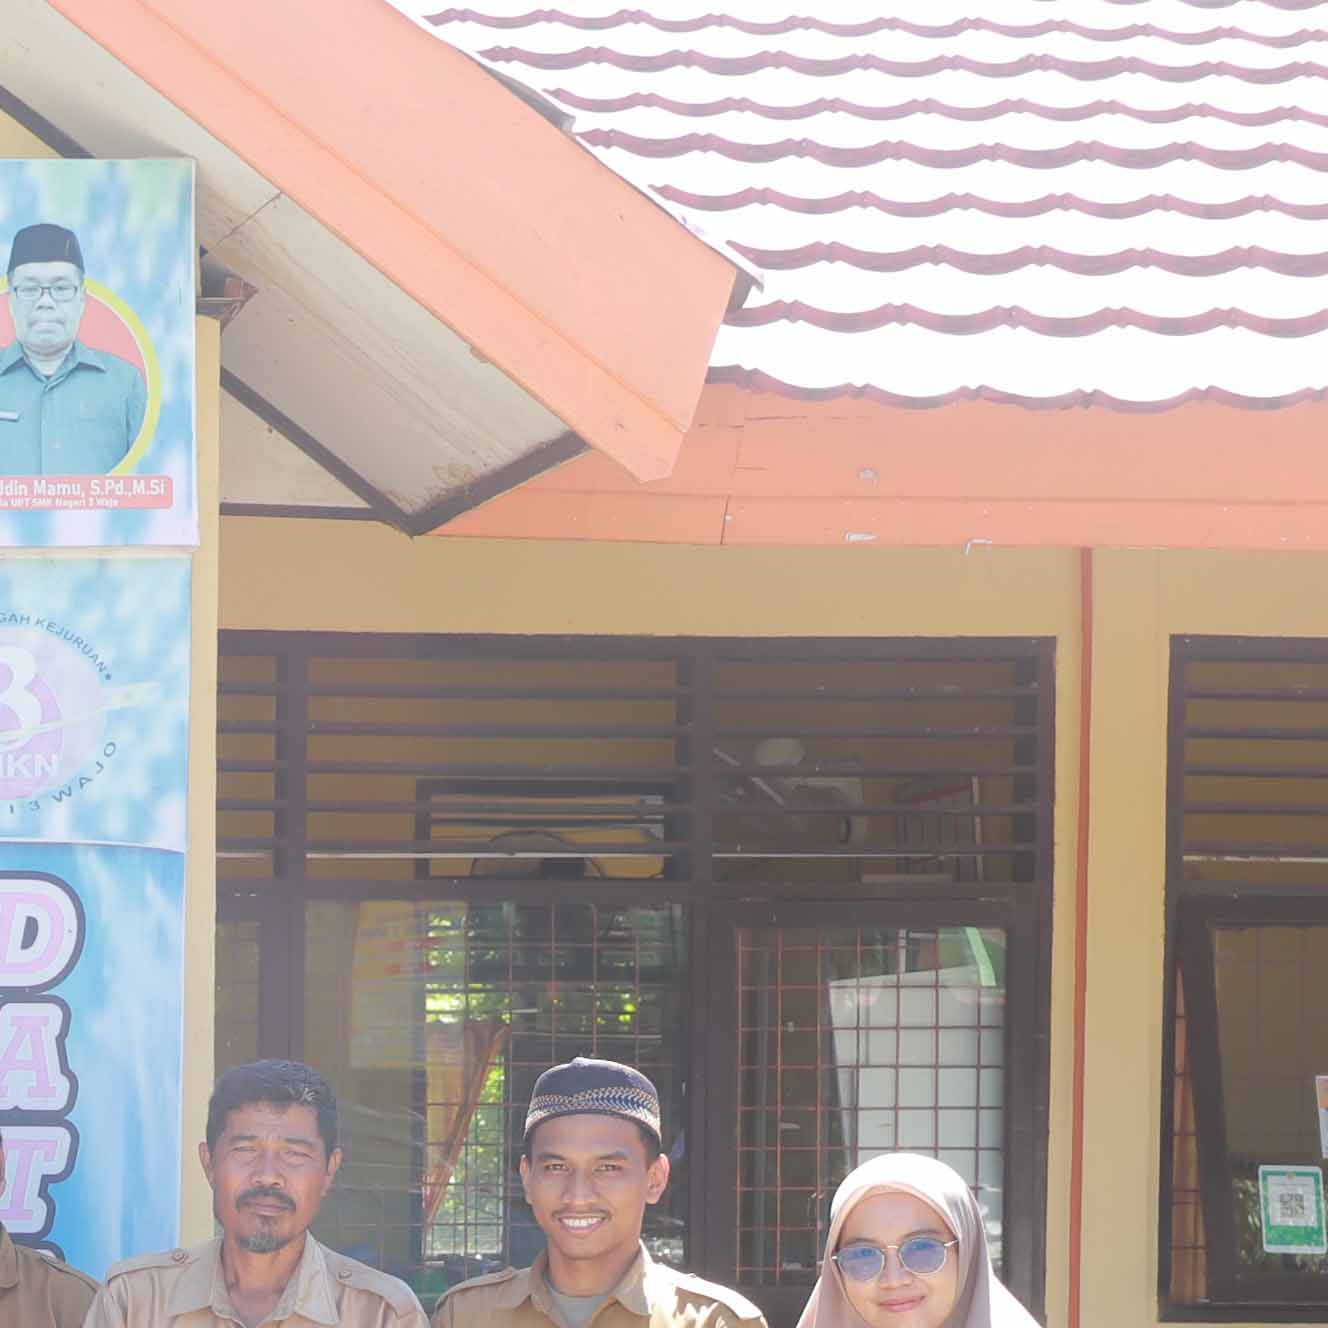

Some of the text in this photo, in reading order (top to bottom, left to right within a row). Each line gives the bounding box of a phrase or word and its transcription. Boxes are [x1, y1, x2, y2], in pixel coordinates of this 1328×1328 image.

[33, 480, 85, 499] Mamu,
[33, 617, 109, 674] KEJURUAN
[28, 800, 42, 814] 3
[51, 741, 118, 804] WAJO
